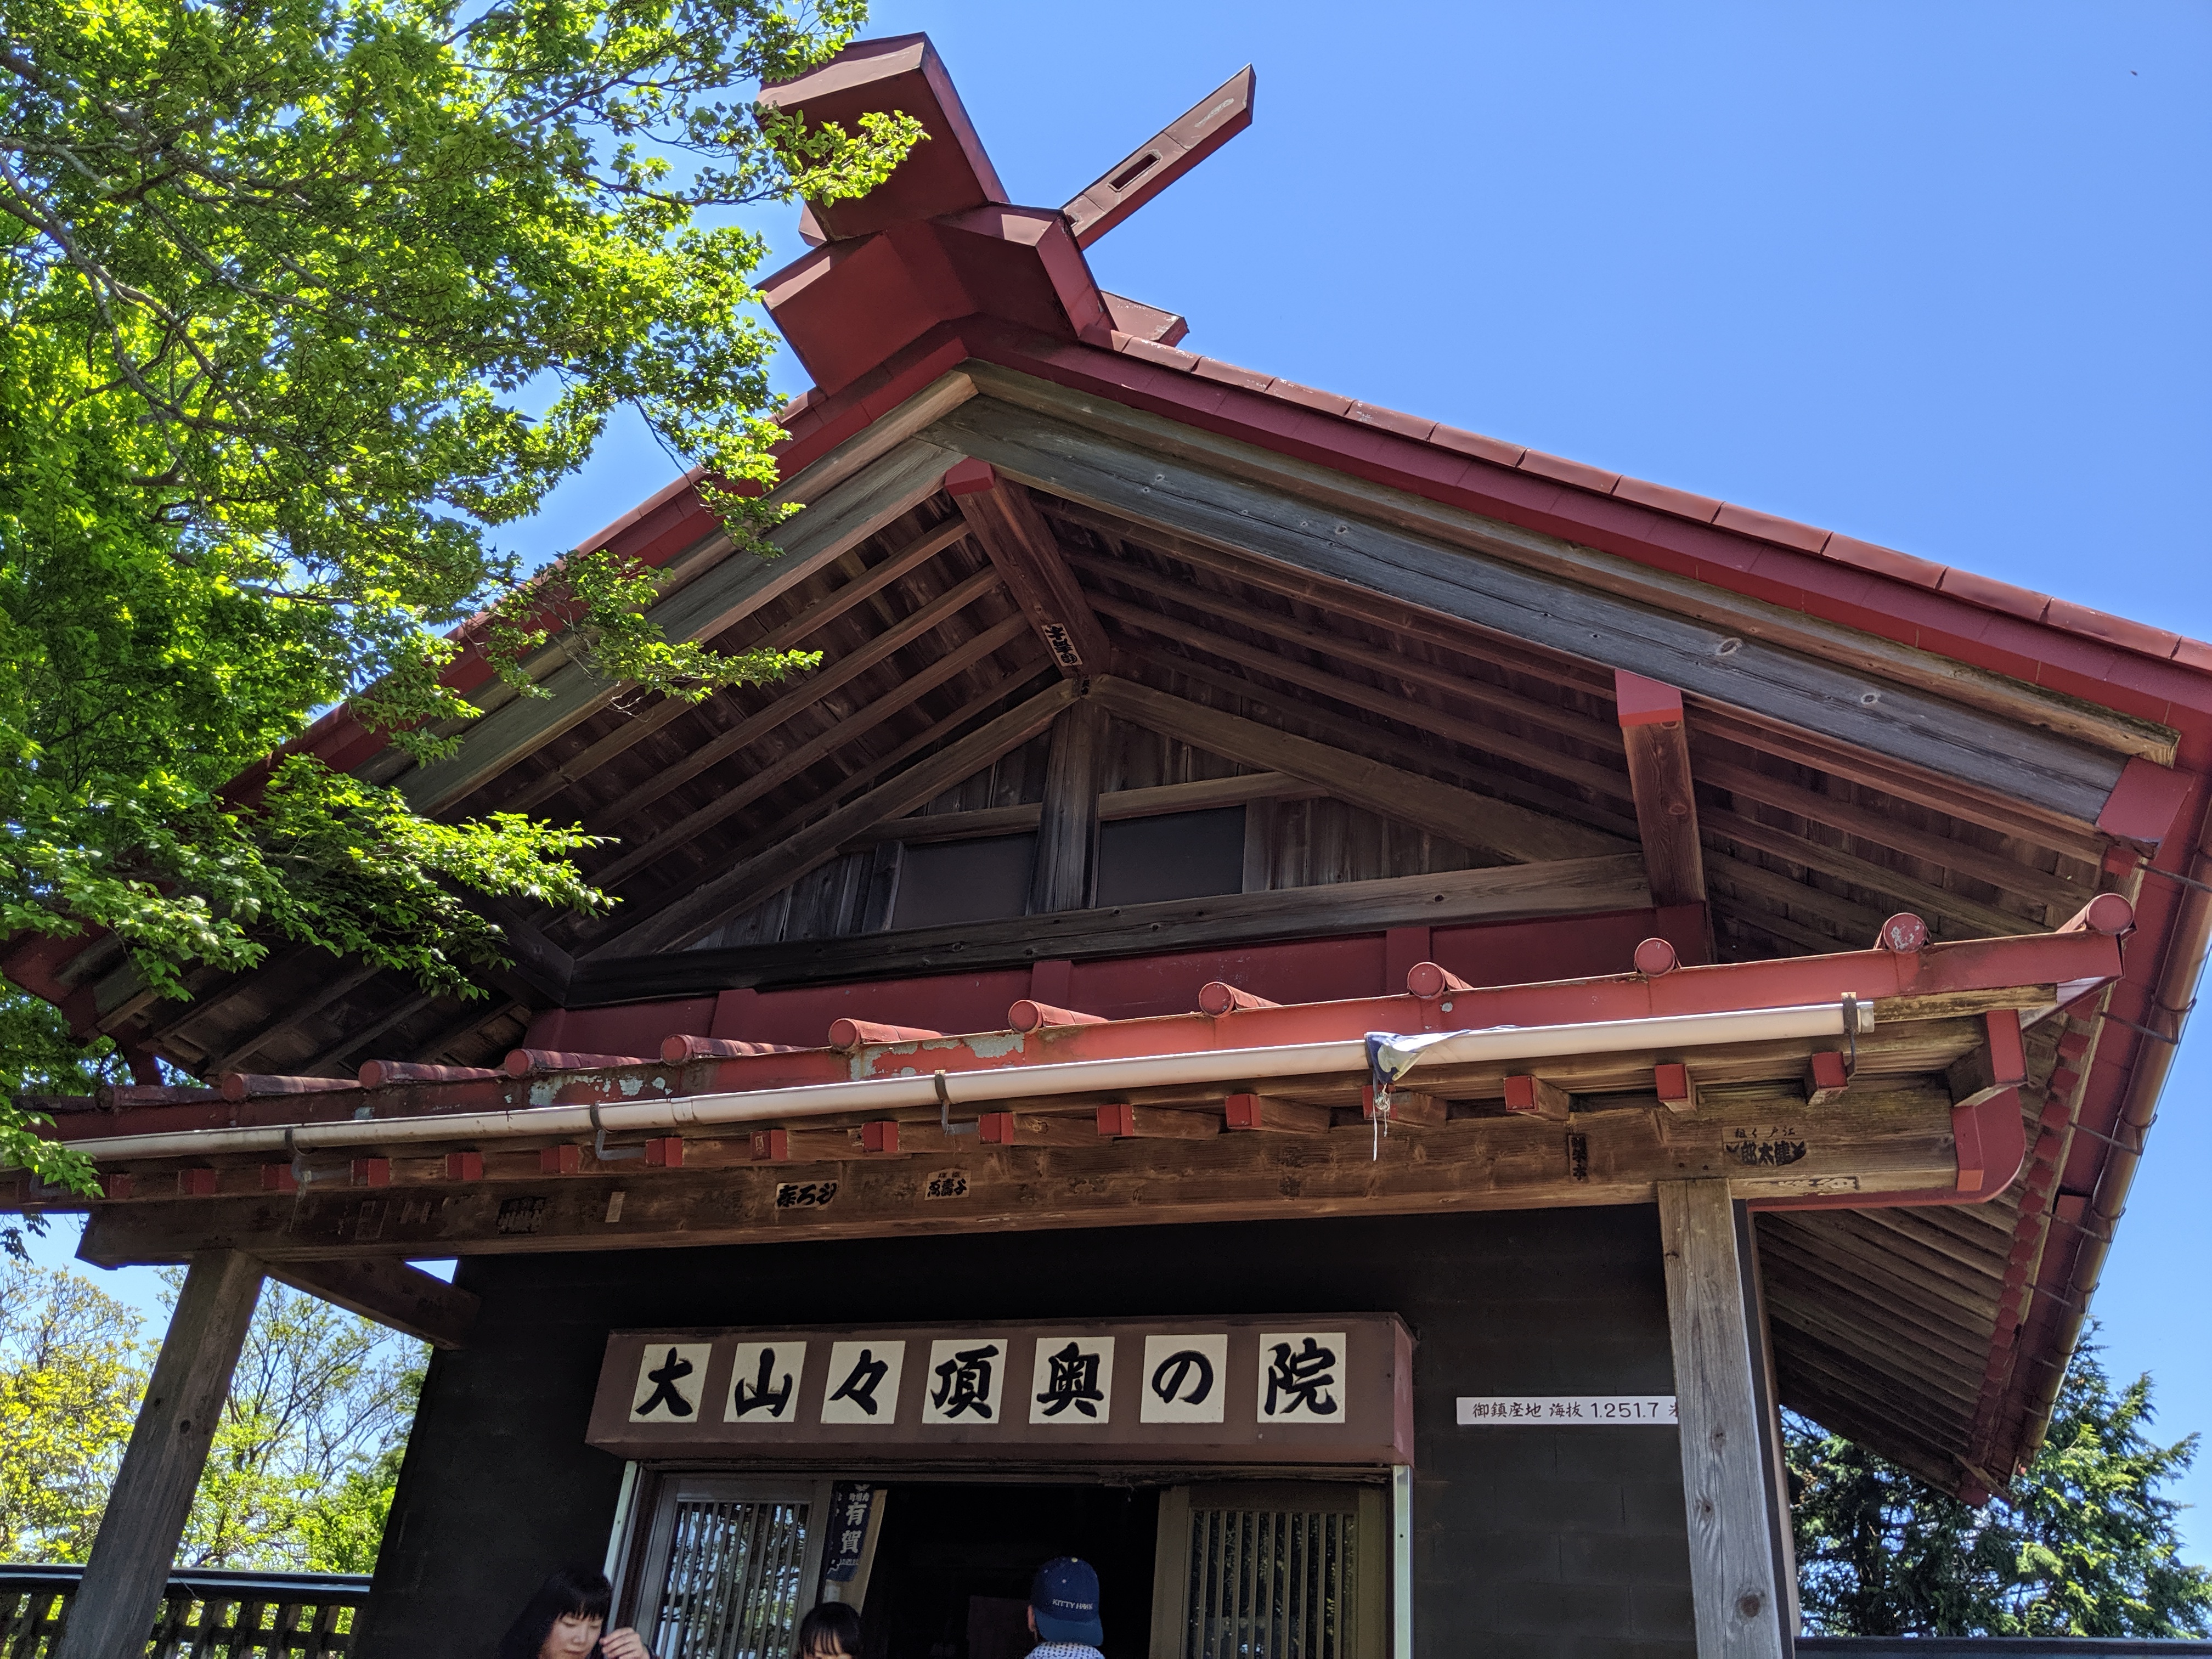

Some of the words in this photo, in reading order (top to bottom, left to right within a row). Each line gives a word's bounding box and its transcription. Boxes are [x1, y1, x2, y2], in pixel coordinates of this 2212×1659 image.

[635, 1337, 1338, 1417] 大山々頂奥の院
[1472, 1402, 1542, 1418] 御鎮座地
[1549, 1401, 1583, 1418] 海抜
[840, 1502, 867, 1554] 有賀
[1052, 1599, 1075, 1609] KITTY
